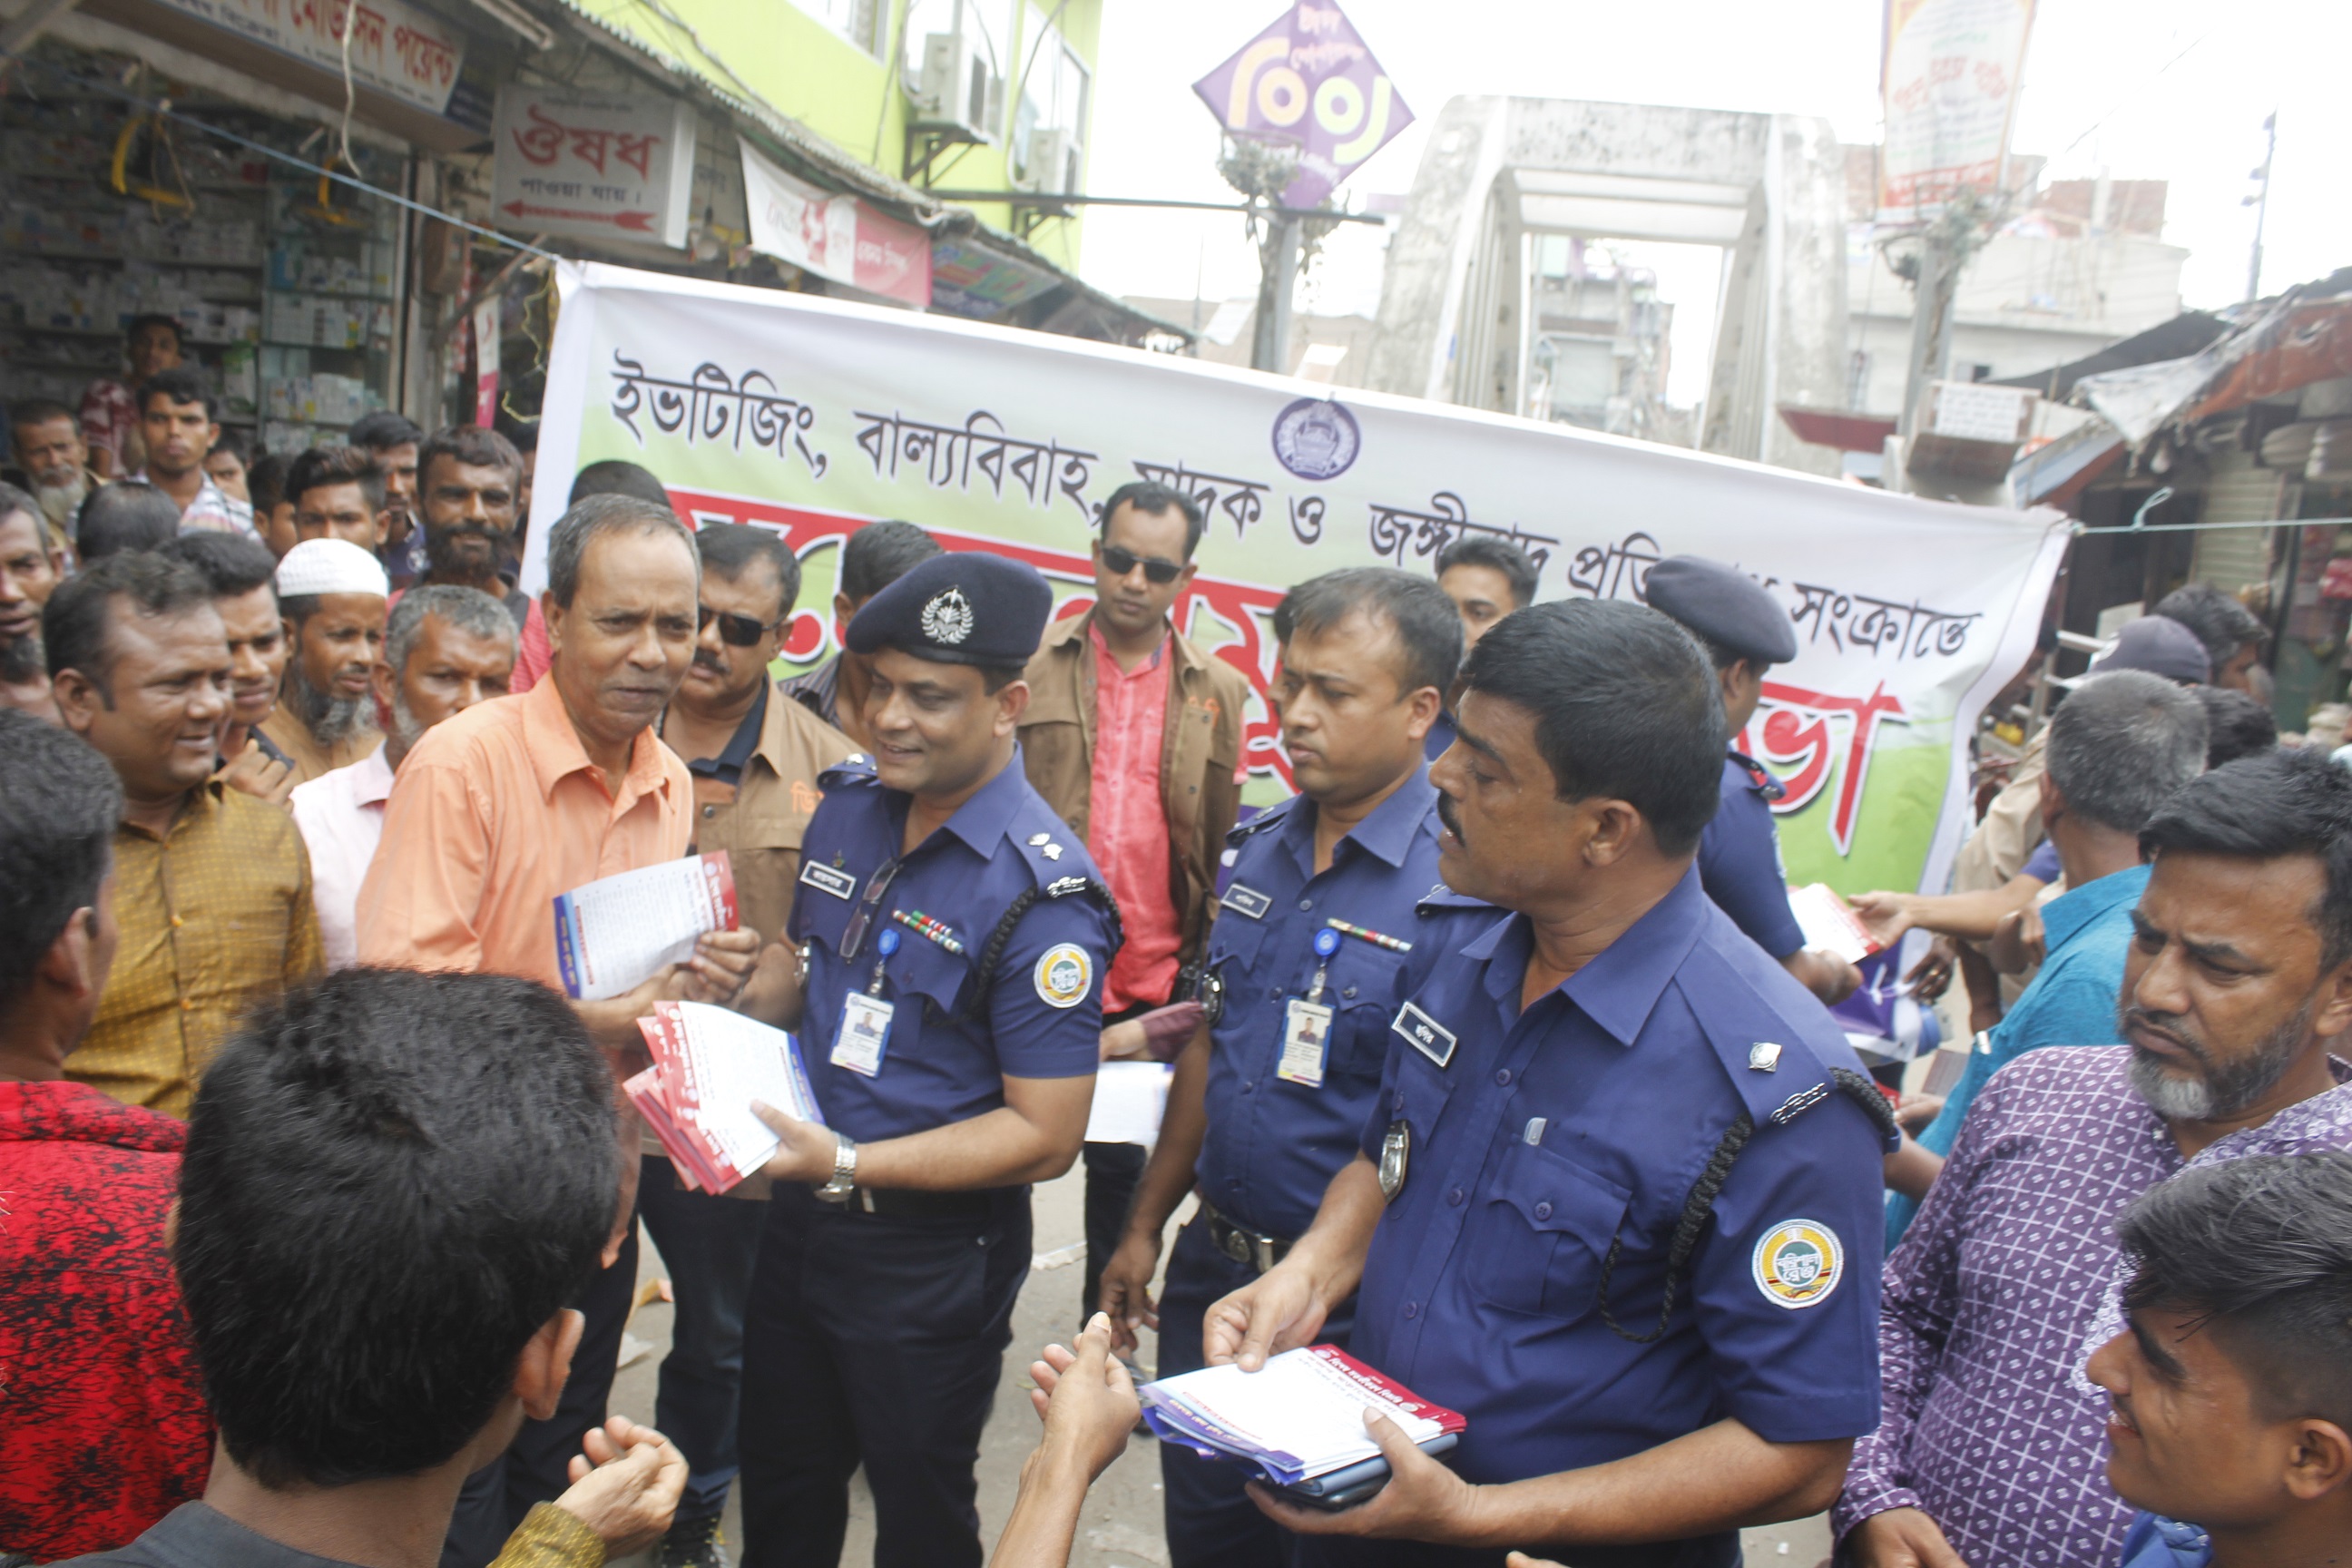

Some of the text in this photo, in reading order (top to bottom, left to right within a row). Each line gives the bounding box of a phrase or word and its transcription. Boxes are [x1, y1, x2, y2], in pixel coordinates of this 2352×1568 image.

[611, 348, 827, 478] ইভটিজিং,
[853, 410, 1104, 527] বাল্যবিবাহ,
[1289, 495, 1326, 544] ও
[1368, 491, 1560, 575] জঙ্গীদ
[1789, 583, 1983, 660] সংক্রান্তে
